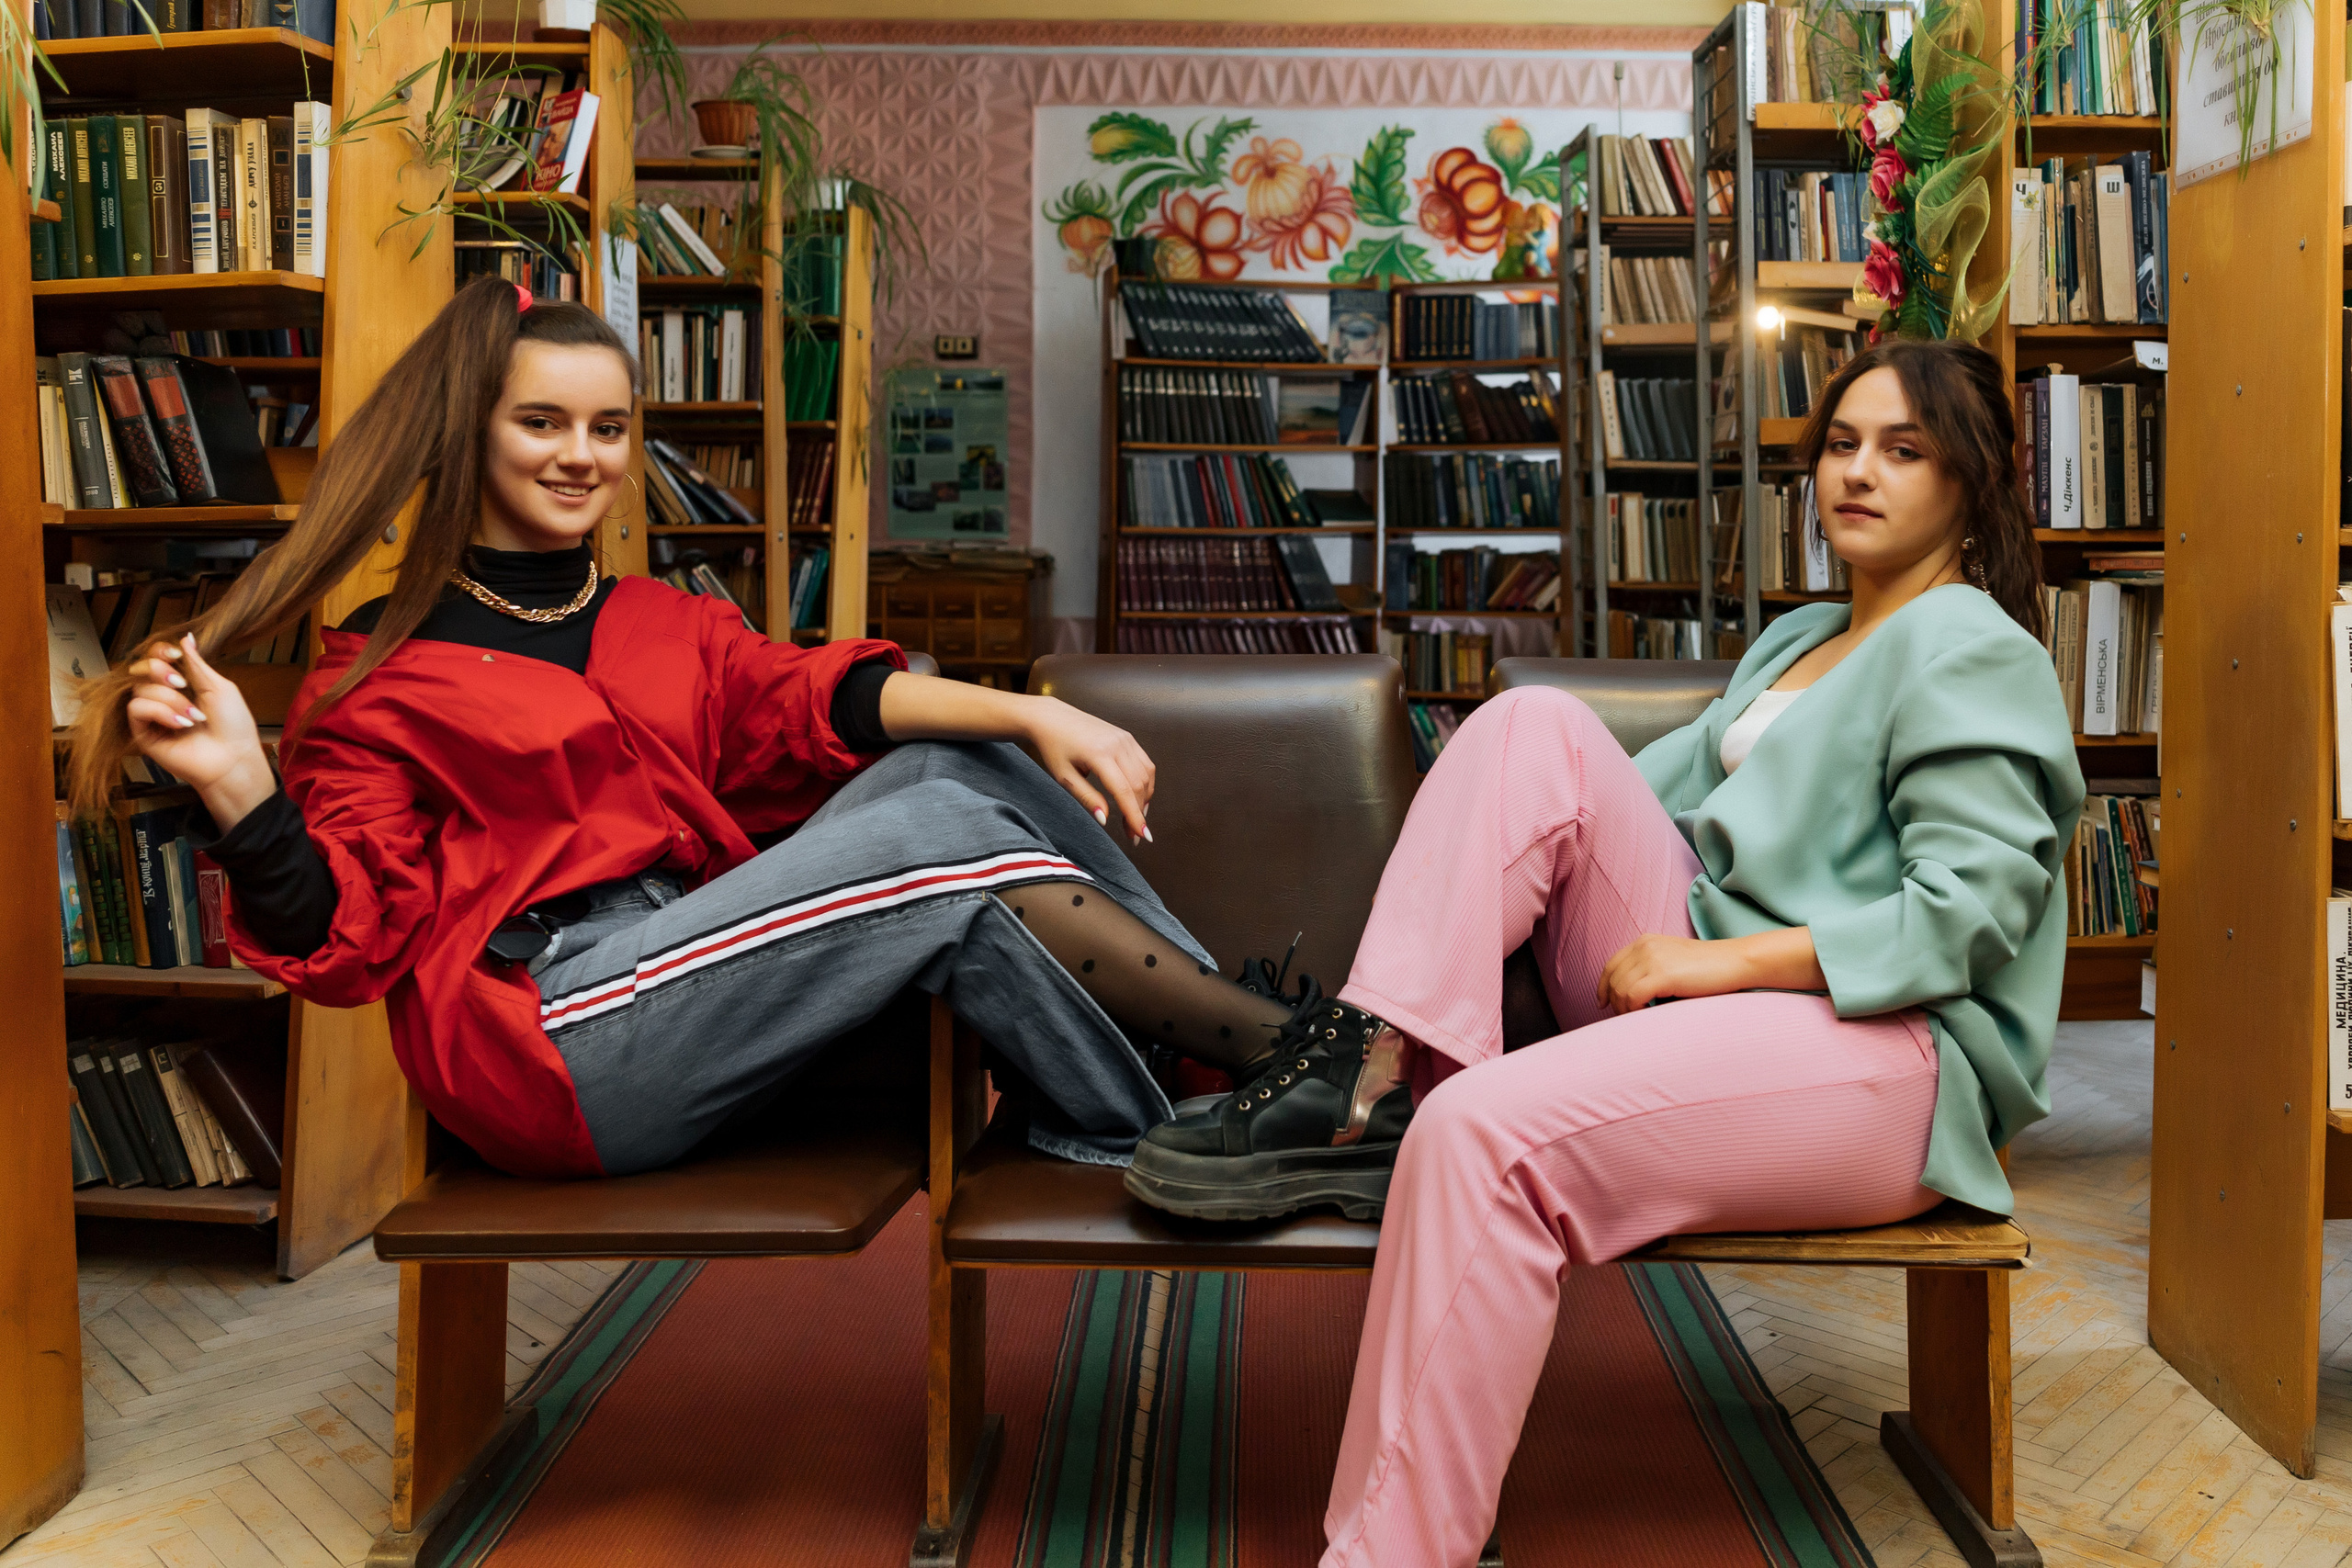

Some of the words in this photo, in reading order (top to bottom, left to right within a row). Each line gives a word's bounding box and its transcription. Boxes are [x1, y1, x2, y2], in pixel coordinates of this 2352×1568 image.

[51, 131, 59, 172] МИХАИЛ
[57, 131, 66, 181] АЛЕКСЕЕВ
[220, 160, 227, 170] НА
[246, 141, 256, 165] УЗАЛА
[247, 166, 257, 189] ДЕРСУ
[2016, 183, 2027, 195] Ч
[2107, 181, 2120, 194] Ш
[2041, 419, 2049, 451] ТАРЗАН
[2041, 461, 2049, 492] МАУГЛІ
[2064, 457, 2074, 513] Ч.Діккенс
[2096, 638, 2108, 714] ВІРМЕНСЬКА
[2335, 952, 2347, 1029] МЕДИЦИНА.
